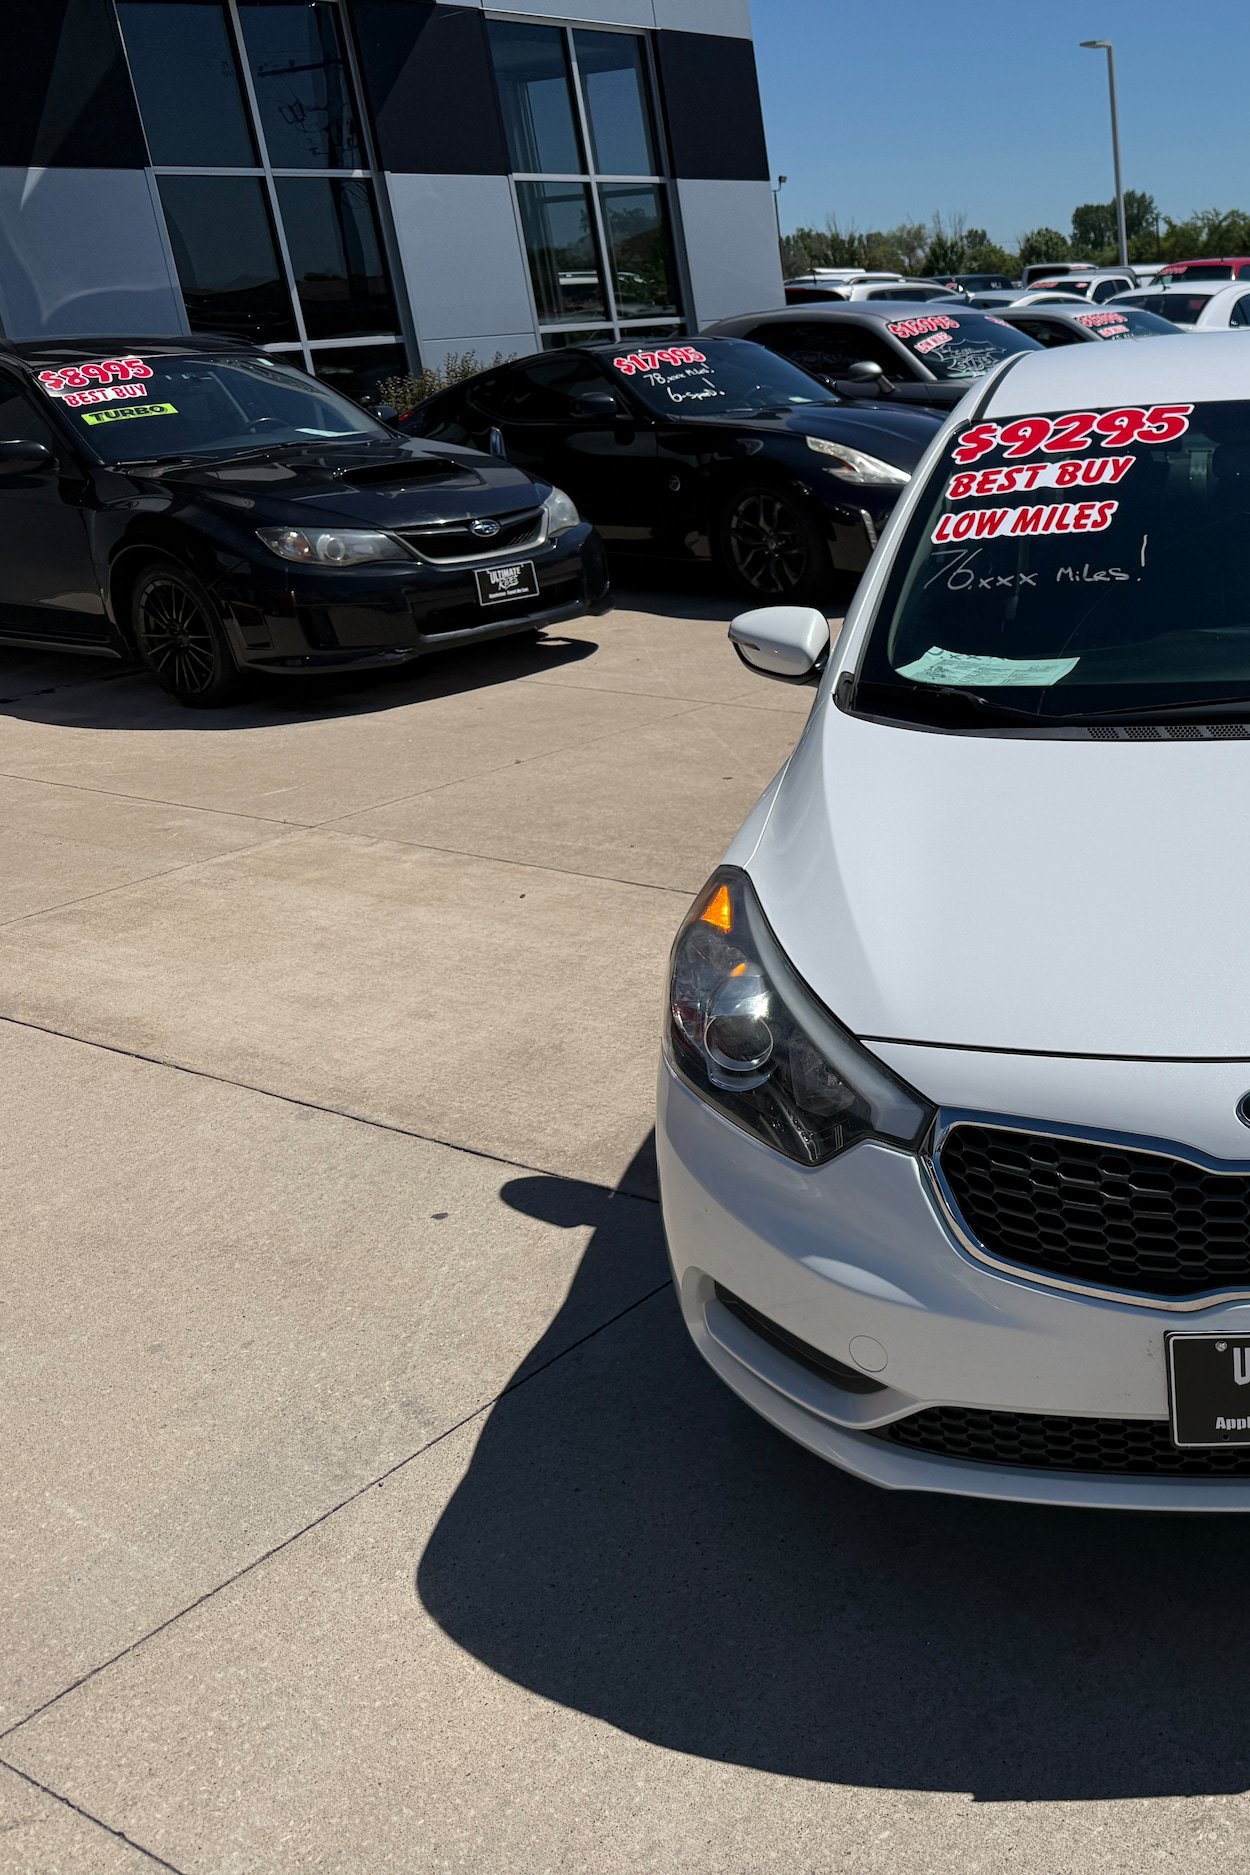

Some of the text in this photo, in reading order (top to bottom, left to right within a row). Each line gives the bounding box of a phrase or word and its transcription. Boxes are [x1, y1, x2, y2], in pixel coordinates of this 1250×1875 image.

[38, 359, 153, 391] $8995
[613, 347, 706, 375] $17995
[65, 384, 147, 407] BEST BUY
[89, 404, 167, 422] TURBO
[952, 404, 1194, 464] $9295
[946, 456, 1136, 499] BEST BUY
[931, 501, 1118, 544] LOW MILES
[490, 566, 521, 584] ULTIMATE
